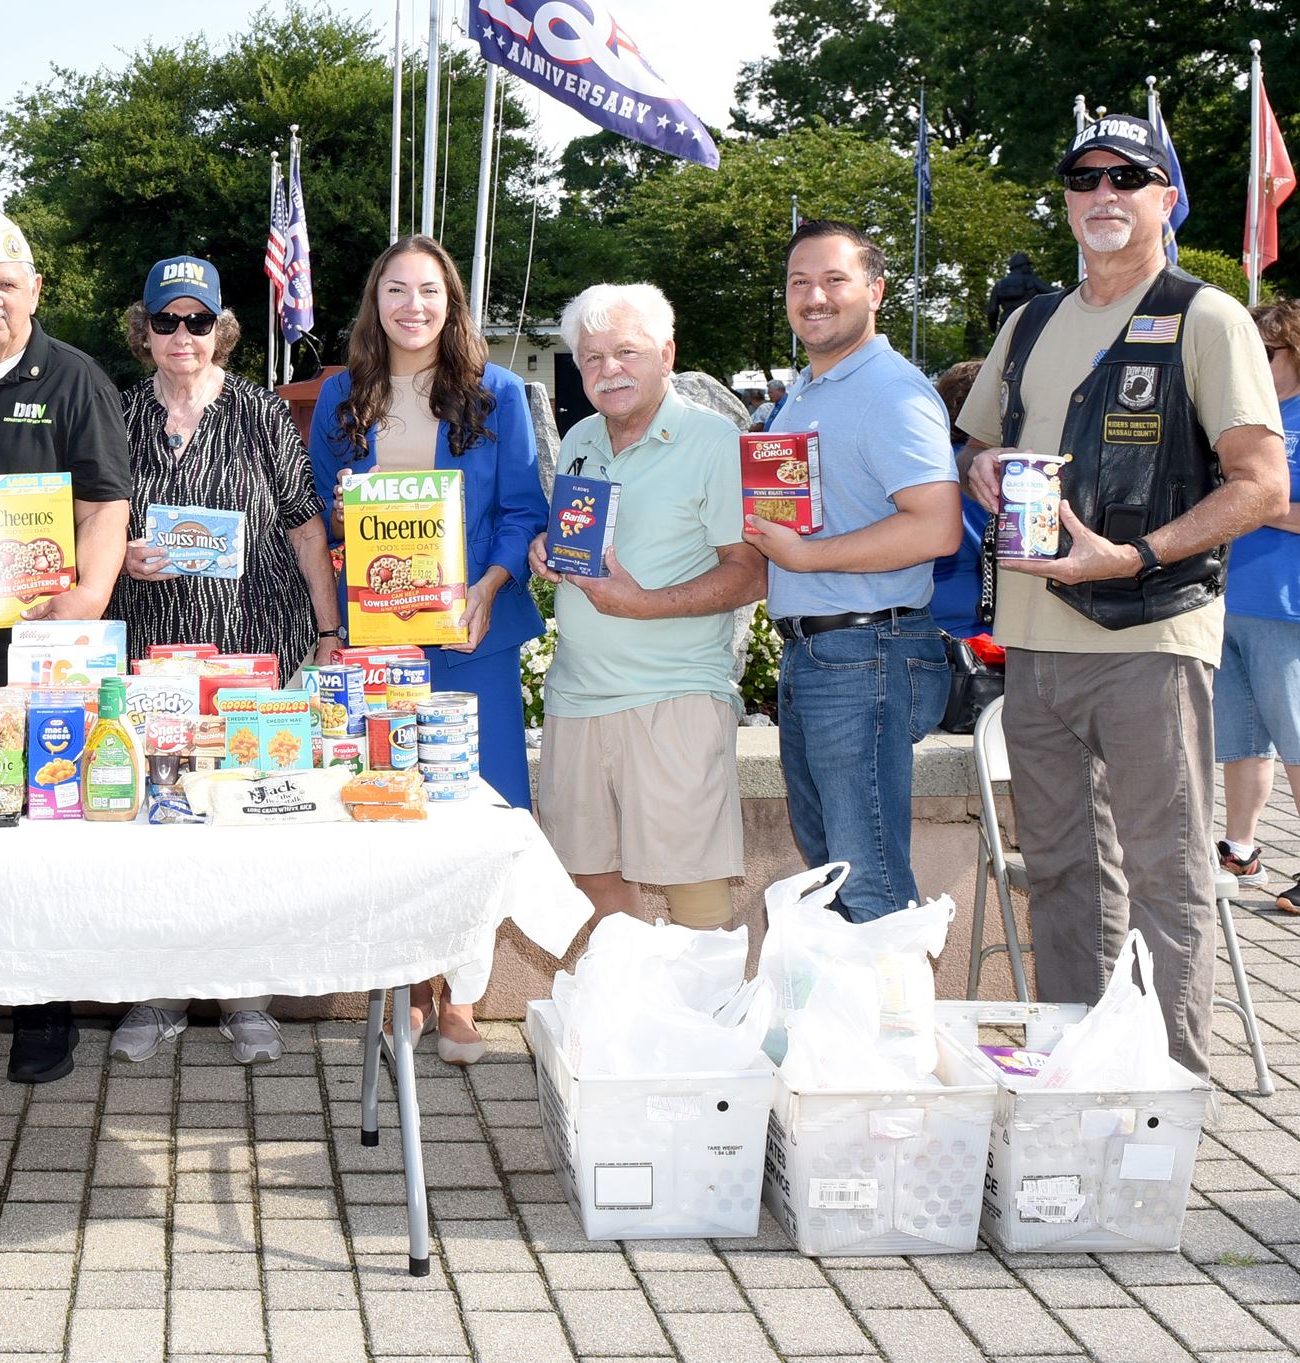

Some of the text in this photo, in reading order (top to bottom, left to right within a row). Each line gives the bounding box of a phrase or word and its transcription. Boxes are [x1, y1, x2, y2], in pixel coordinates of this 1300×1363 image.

[507, 42, 651, 124] ANNIVERSARY
[1073, 119, 1148, 151] AIR FORCE
[1129, 421, 1158, 429] DIRECTOR
[752, 448, 793, 460] GIORGIO
[360, 476, 439, 502] MEGA
[562, 511, 592, 525] Barilla
[360, 515, 446, 541] Cheerios
[416, 543, 440, 551] OATS
[363, 593, 440, 608] LOWER CHOLESTEROL
[404, 589, 420, 597] HELP
[126, 692, 194, 714] Teddy
[258, 701, 309, 714] GOODLES
[62, 726, 69, 734] &
[149, 723, 188, 738] Snack
[157, 734, 188, 748] pack
[766, 1133, 787, 1171] TATES
[765, 1155, 790, 1199] ERVICE
